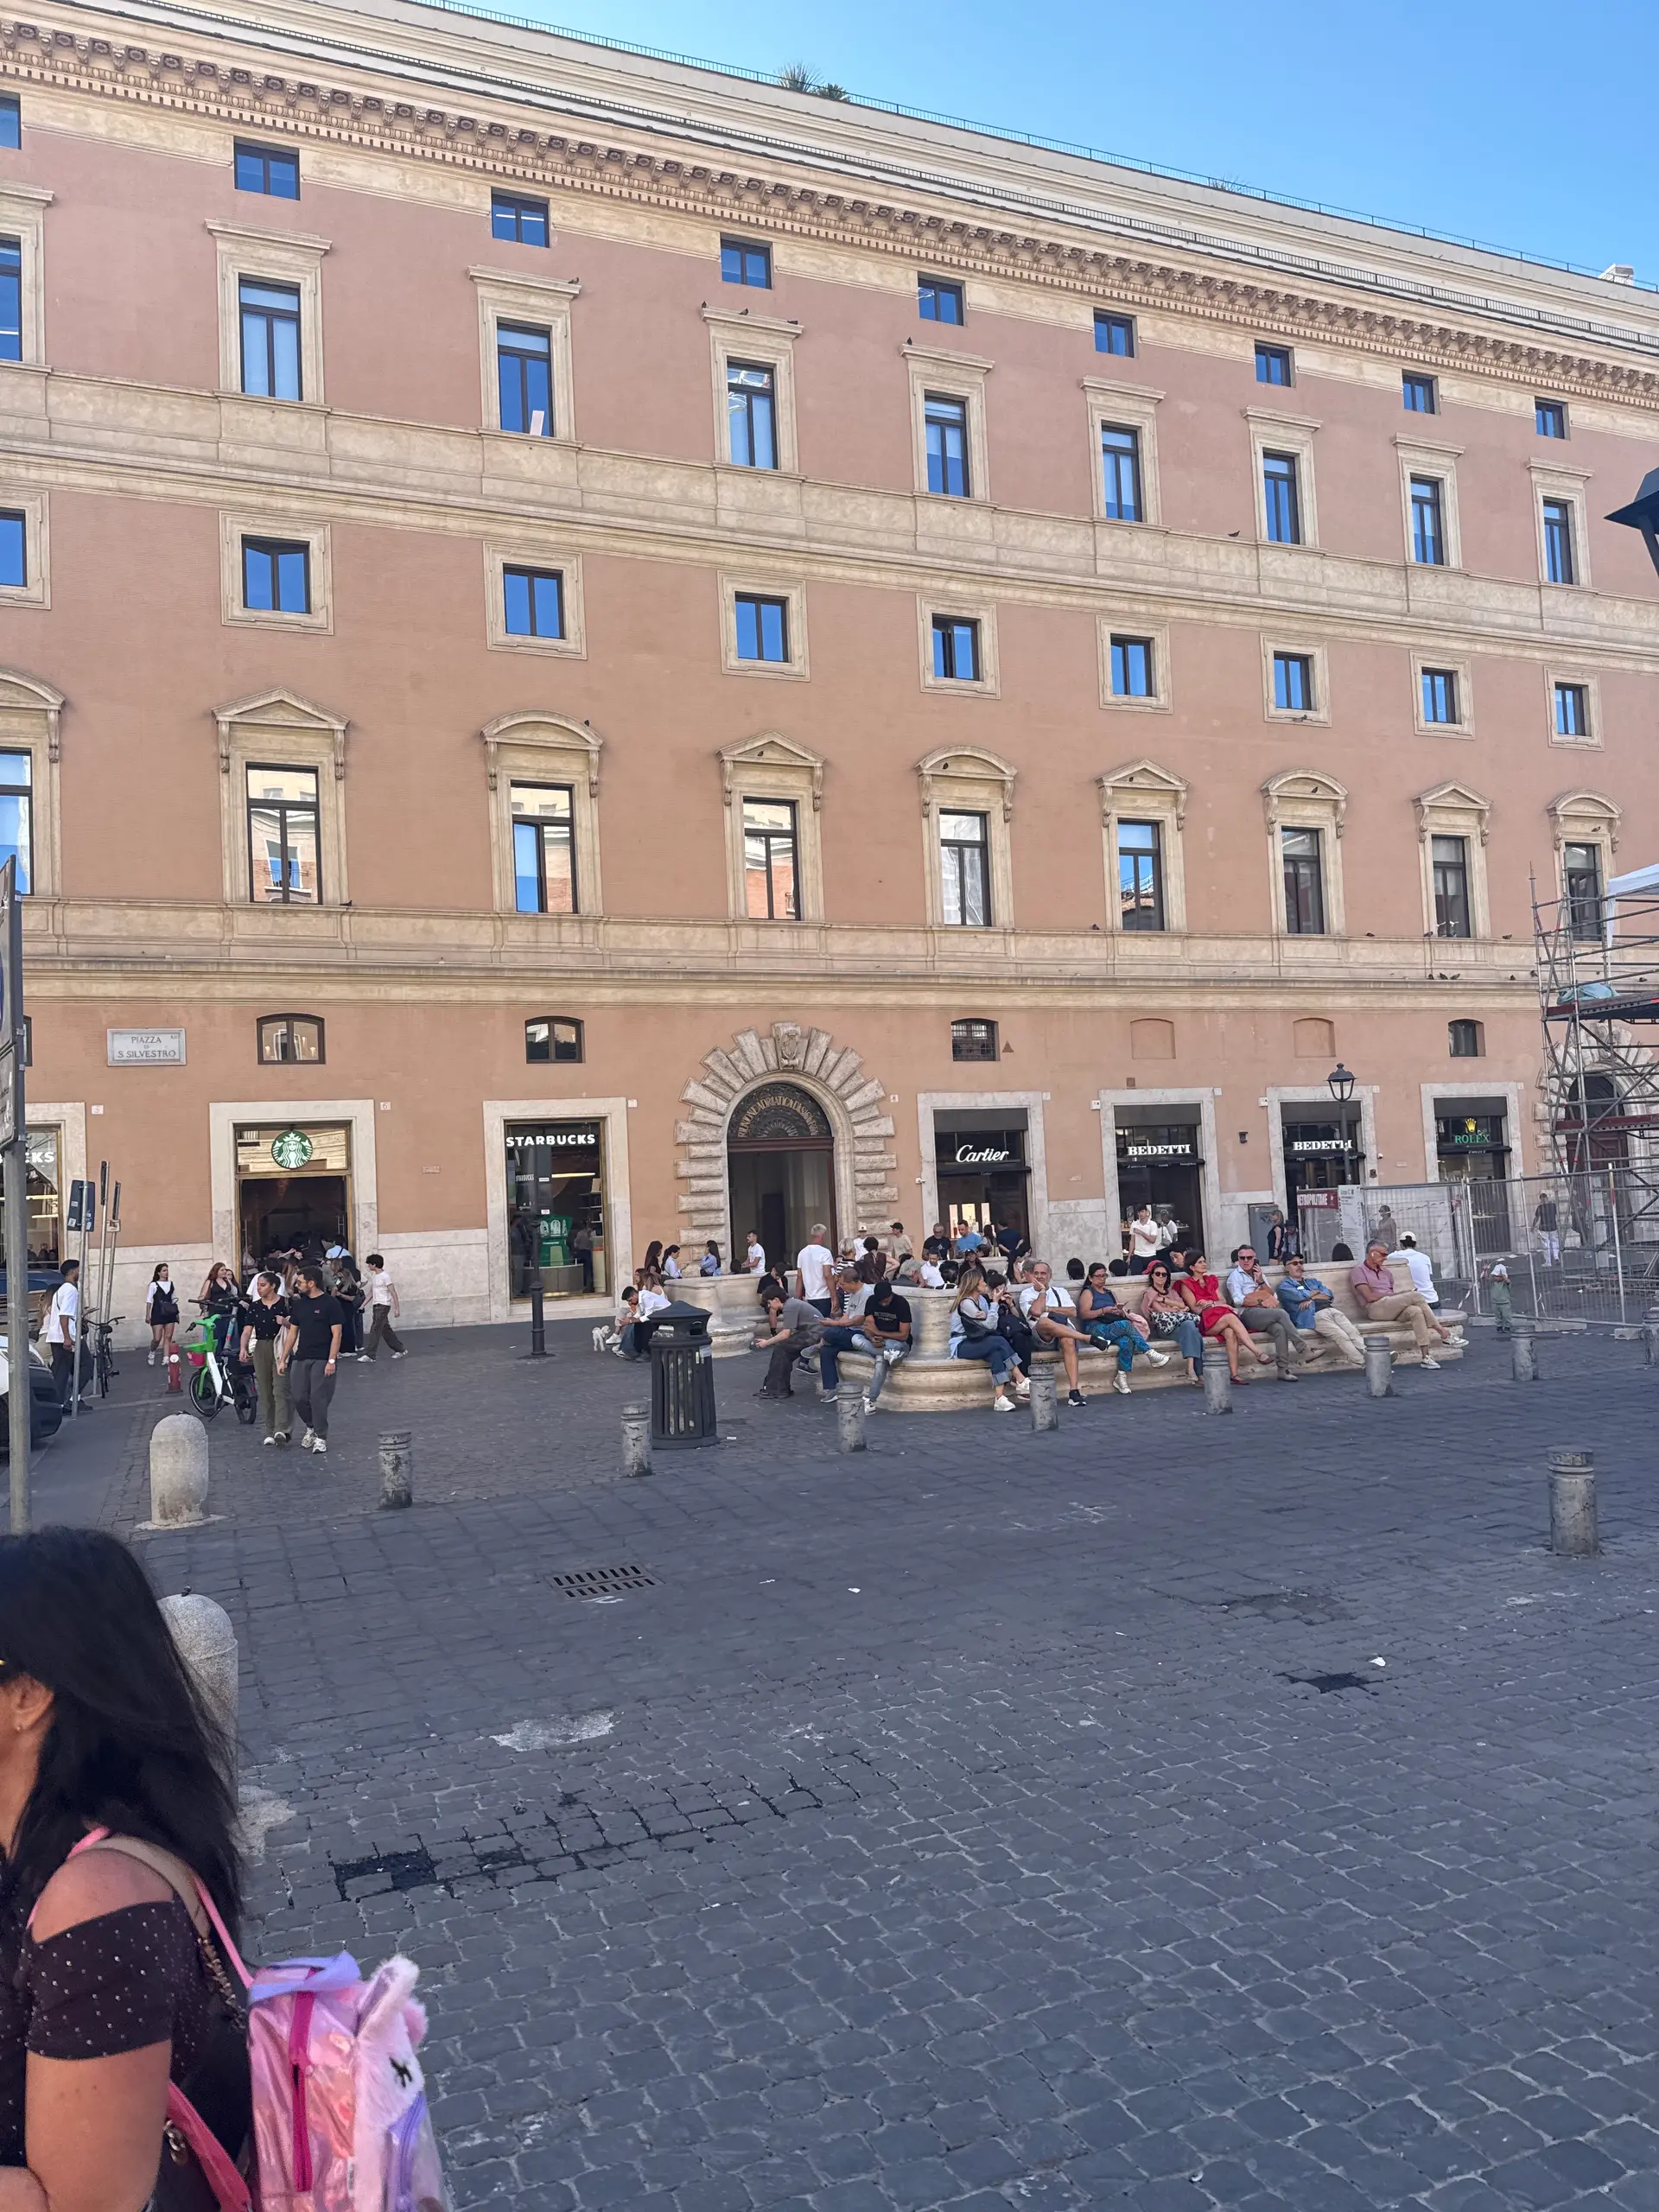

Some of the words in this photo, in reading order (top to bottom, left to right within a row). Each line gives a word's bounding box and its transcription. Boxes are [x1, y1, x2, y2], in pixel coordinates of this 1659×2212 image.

[126, 1050, 176, 1058] SILVESTRO
[505, 1134, 595, 1147] STARBUCKS
[1292, 1139, 1353, 1151] BEDETTI
[1454, 1135, 1491, 1144] ROLEX
[956, 1144, 1009, 1163] Cartier
[1127, 1143, 1192, 1156] BEDETTI
